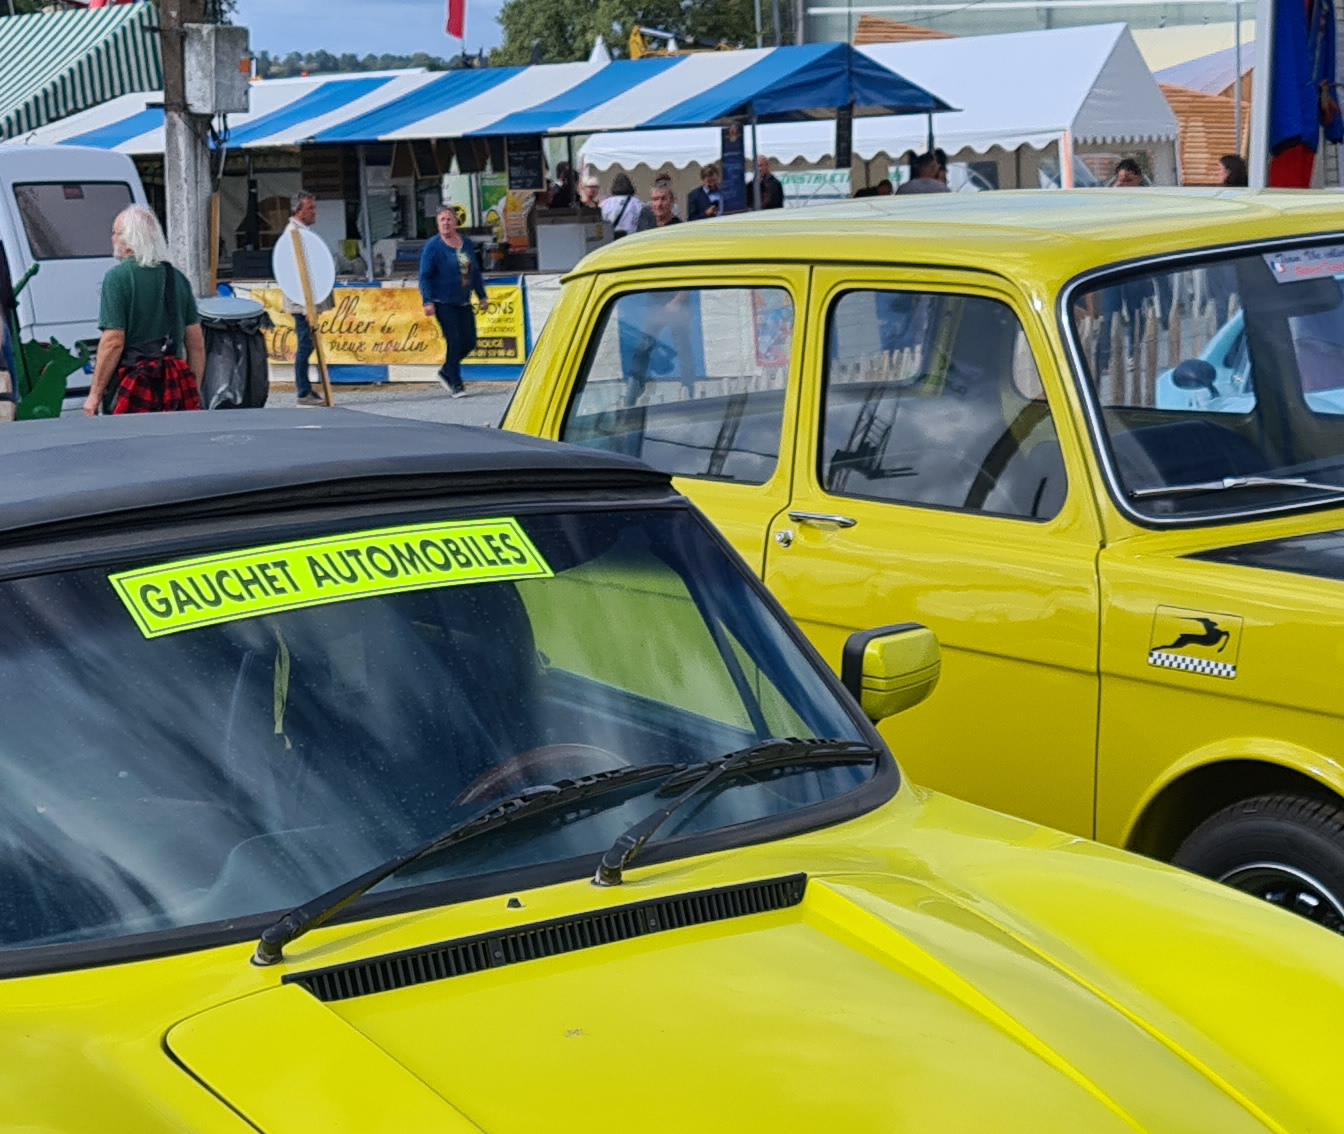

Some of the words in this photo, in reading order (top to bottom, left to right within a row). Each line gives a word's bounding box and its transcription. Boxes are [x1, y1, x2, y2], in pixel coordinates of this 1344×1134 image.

[318, 296, 375, 334] ellier
[372, 323, 429, 353] moulin
[139, 560, 302, 619] GAUCHET
[306, 532, 529, 589] AUTOMOBILES
